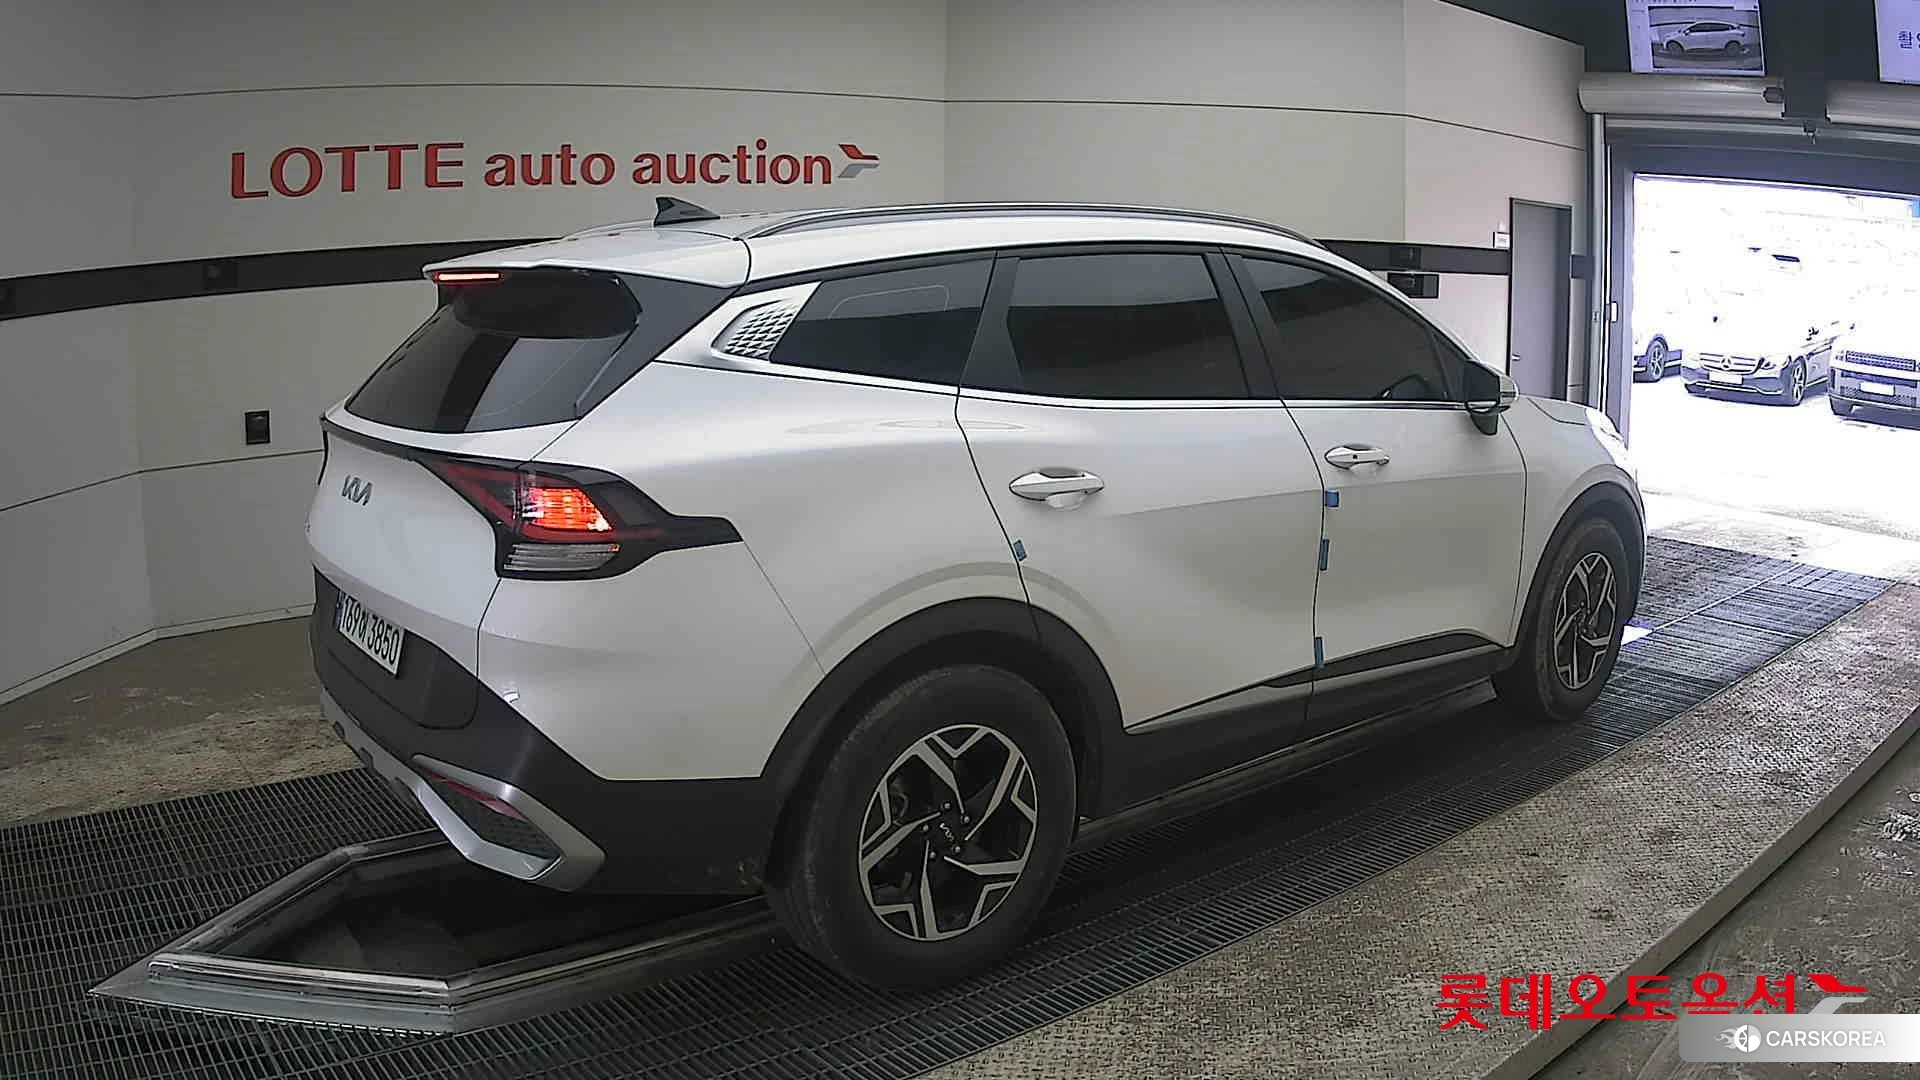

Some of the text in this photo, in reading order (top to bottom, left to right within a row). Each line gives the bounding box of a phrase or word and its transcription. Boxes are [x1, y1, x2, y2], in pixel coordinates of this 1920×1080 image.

[231, 138, 832, 199] LOTTE auto auction
[367, 614, 400, 666] 3850
